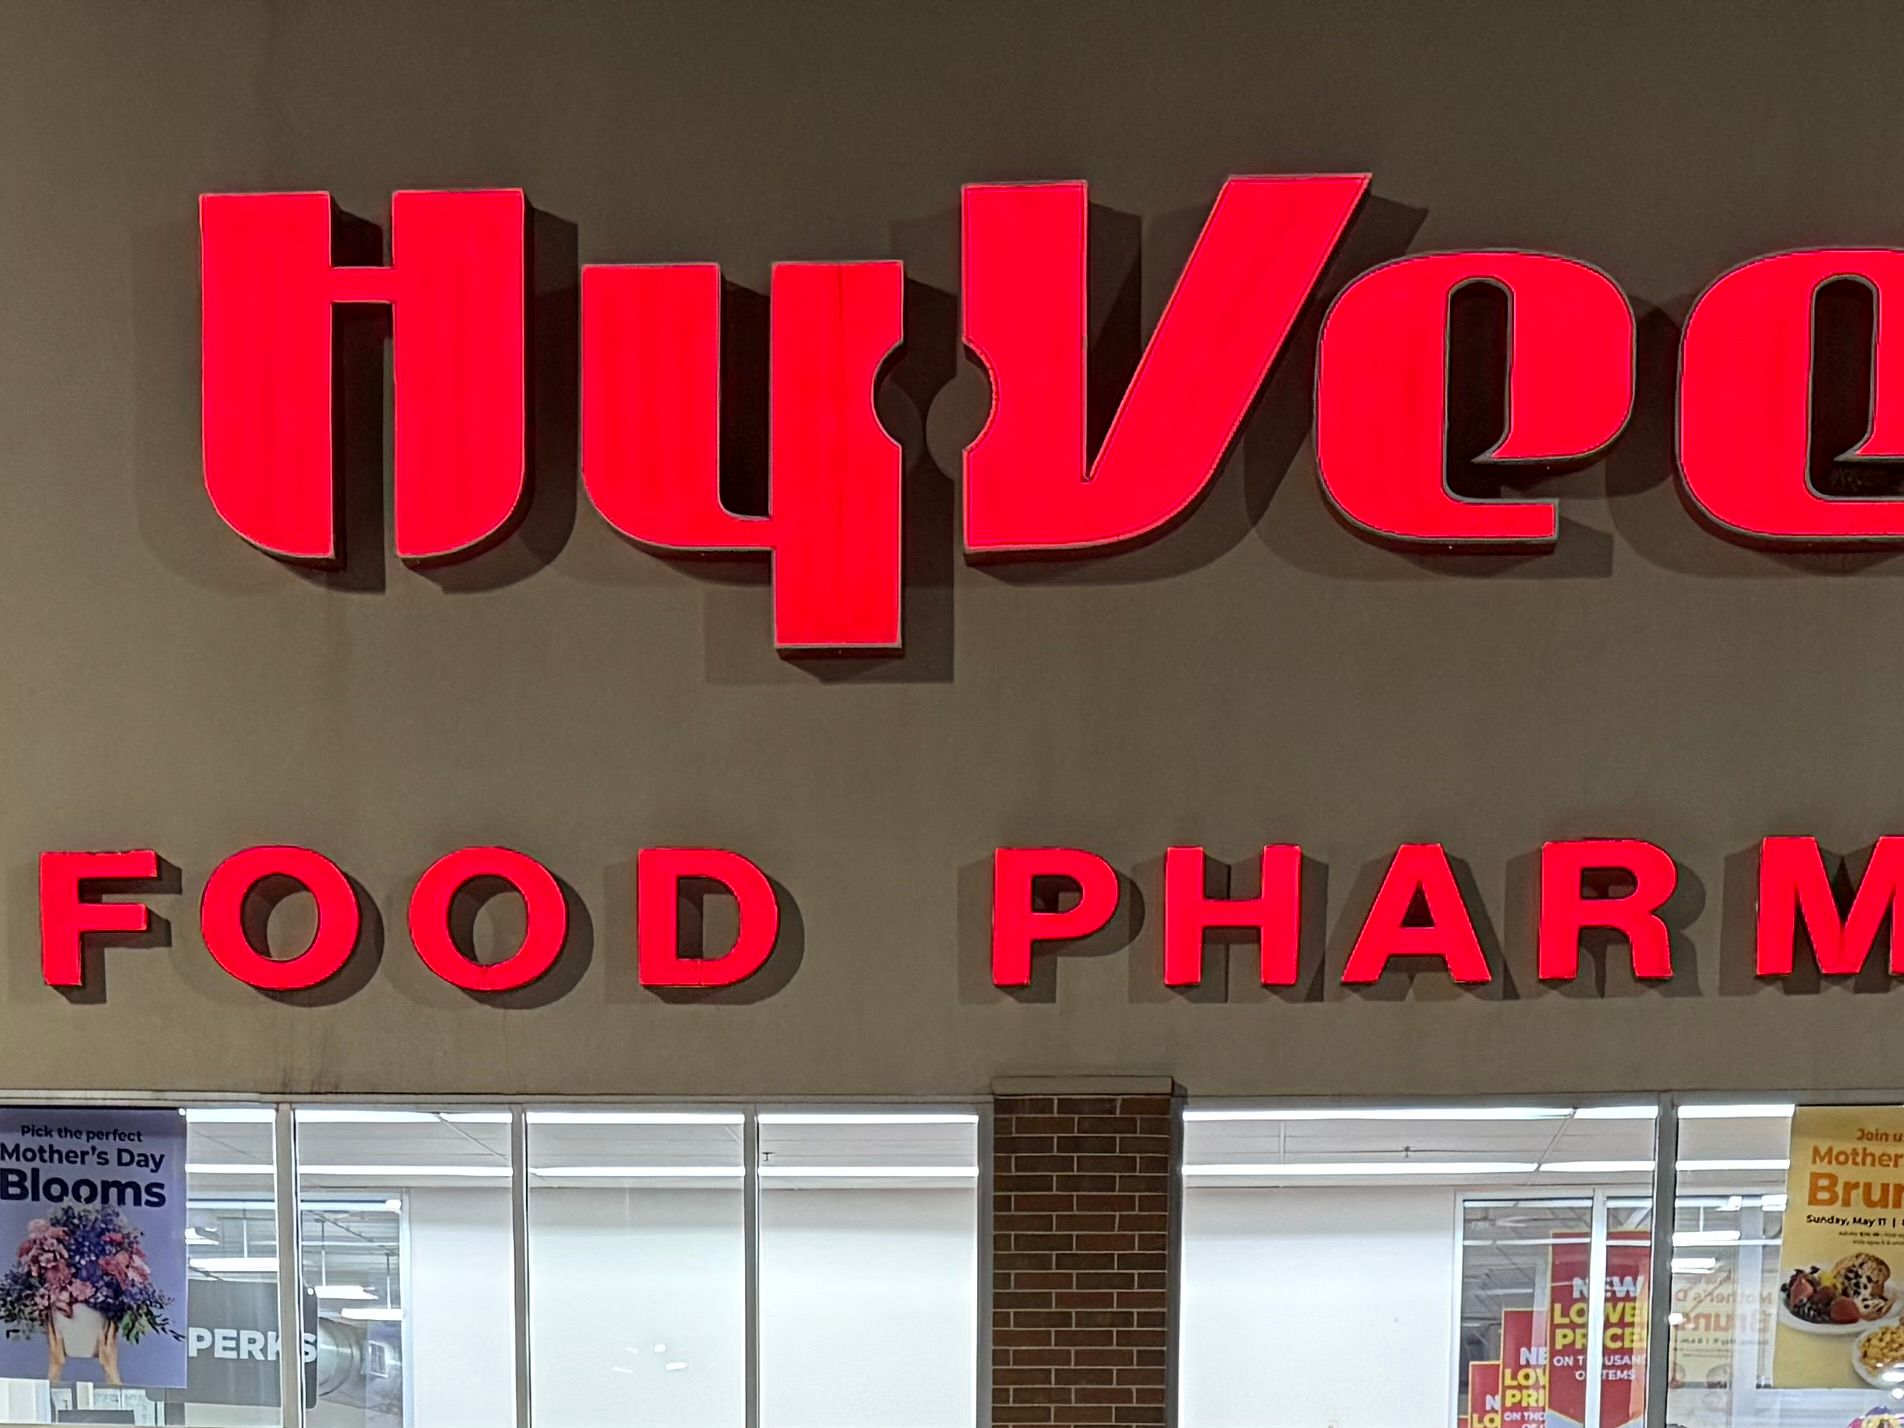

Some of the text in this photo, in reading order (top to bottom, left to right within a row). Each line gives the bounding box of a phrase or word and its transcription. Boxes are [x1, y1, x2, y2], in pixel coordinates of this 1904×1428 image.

[39, 846, 779, 991] FOOD
[20, 1125, 143, 1143] Pick the perfect
[1856, 1128, 1889, 1143] Join
[0, 1142, 165, 1173] Mother's Day
[0, 1167, 166, 1208] Blooms
[1852, 1216, 1875, 1227] May
